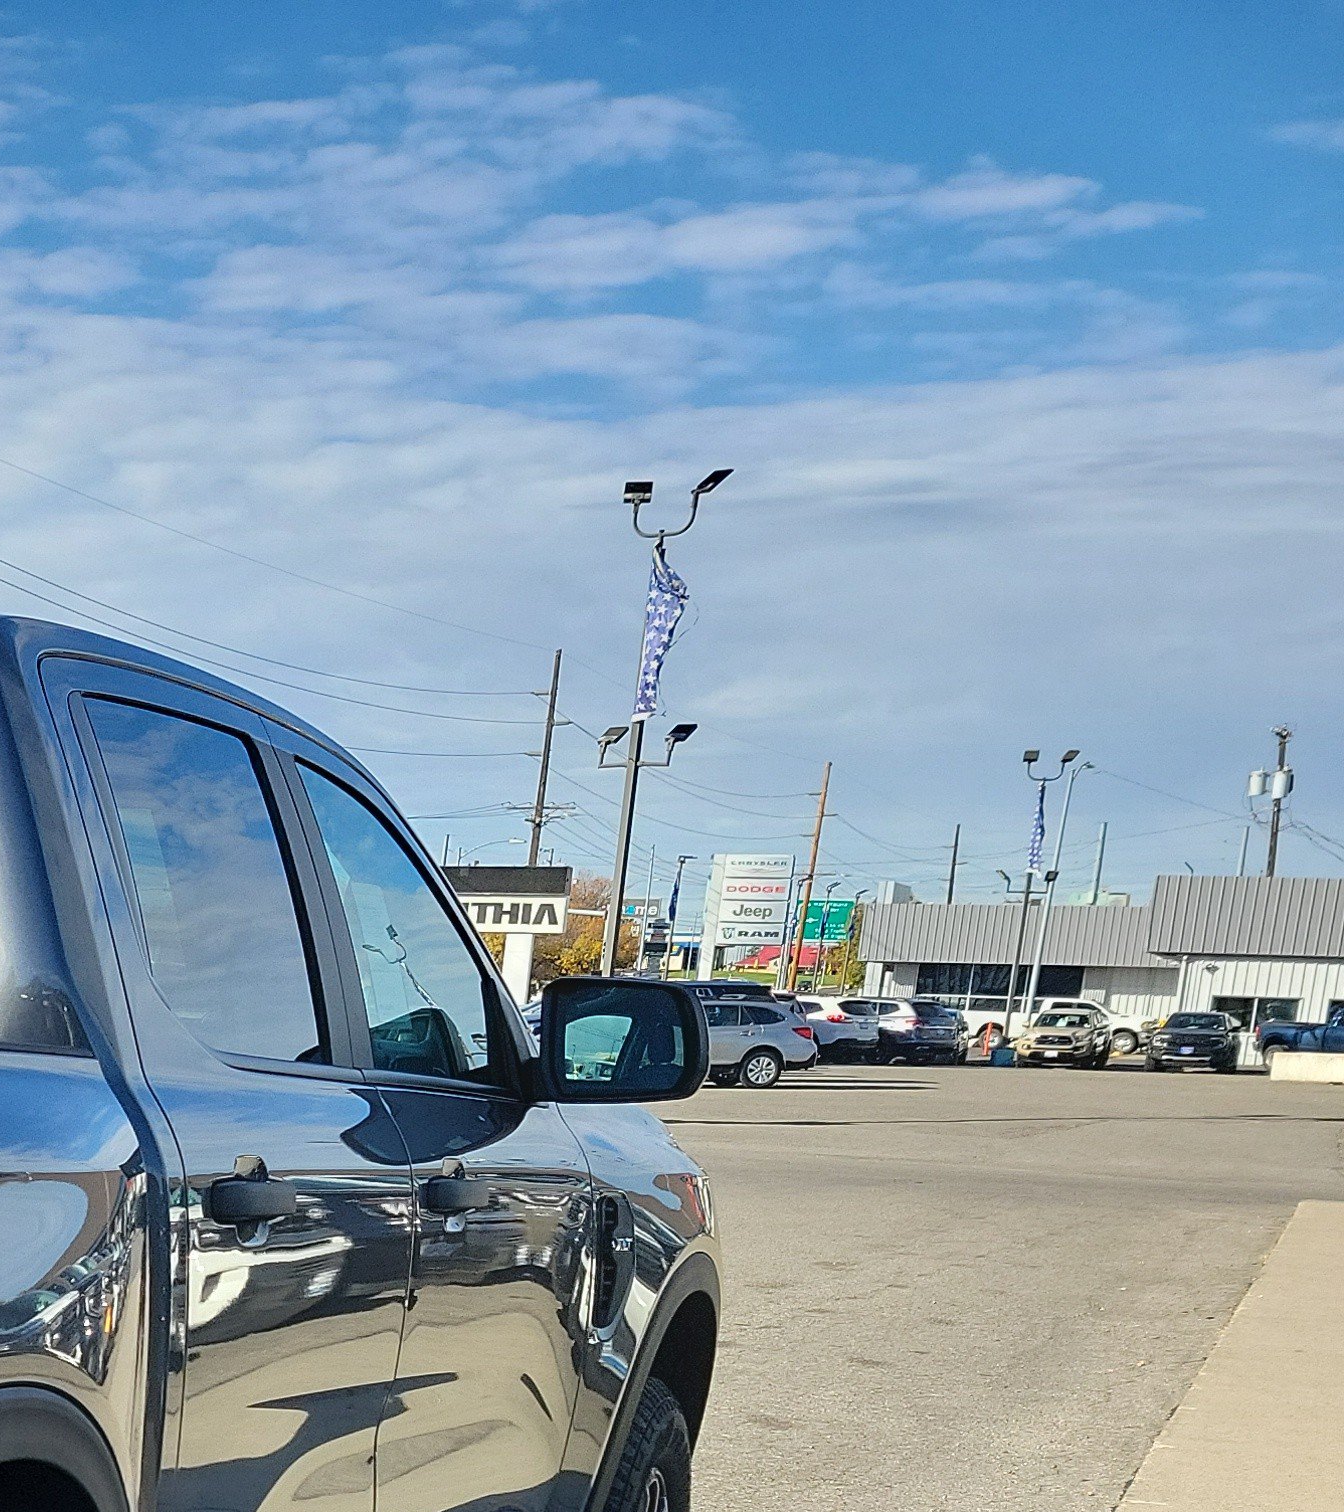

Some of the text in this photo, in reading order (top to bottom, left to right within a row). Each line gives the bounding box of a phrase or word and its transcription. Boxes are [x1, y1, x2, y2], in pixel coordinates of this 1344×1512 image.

[726, 885, 786, 893] DODGE
[732, 904, 773, 920] Jeep
[737, 929, 780, 938] RAM
